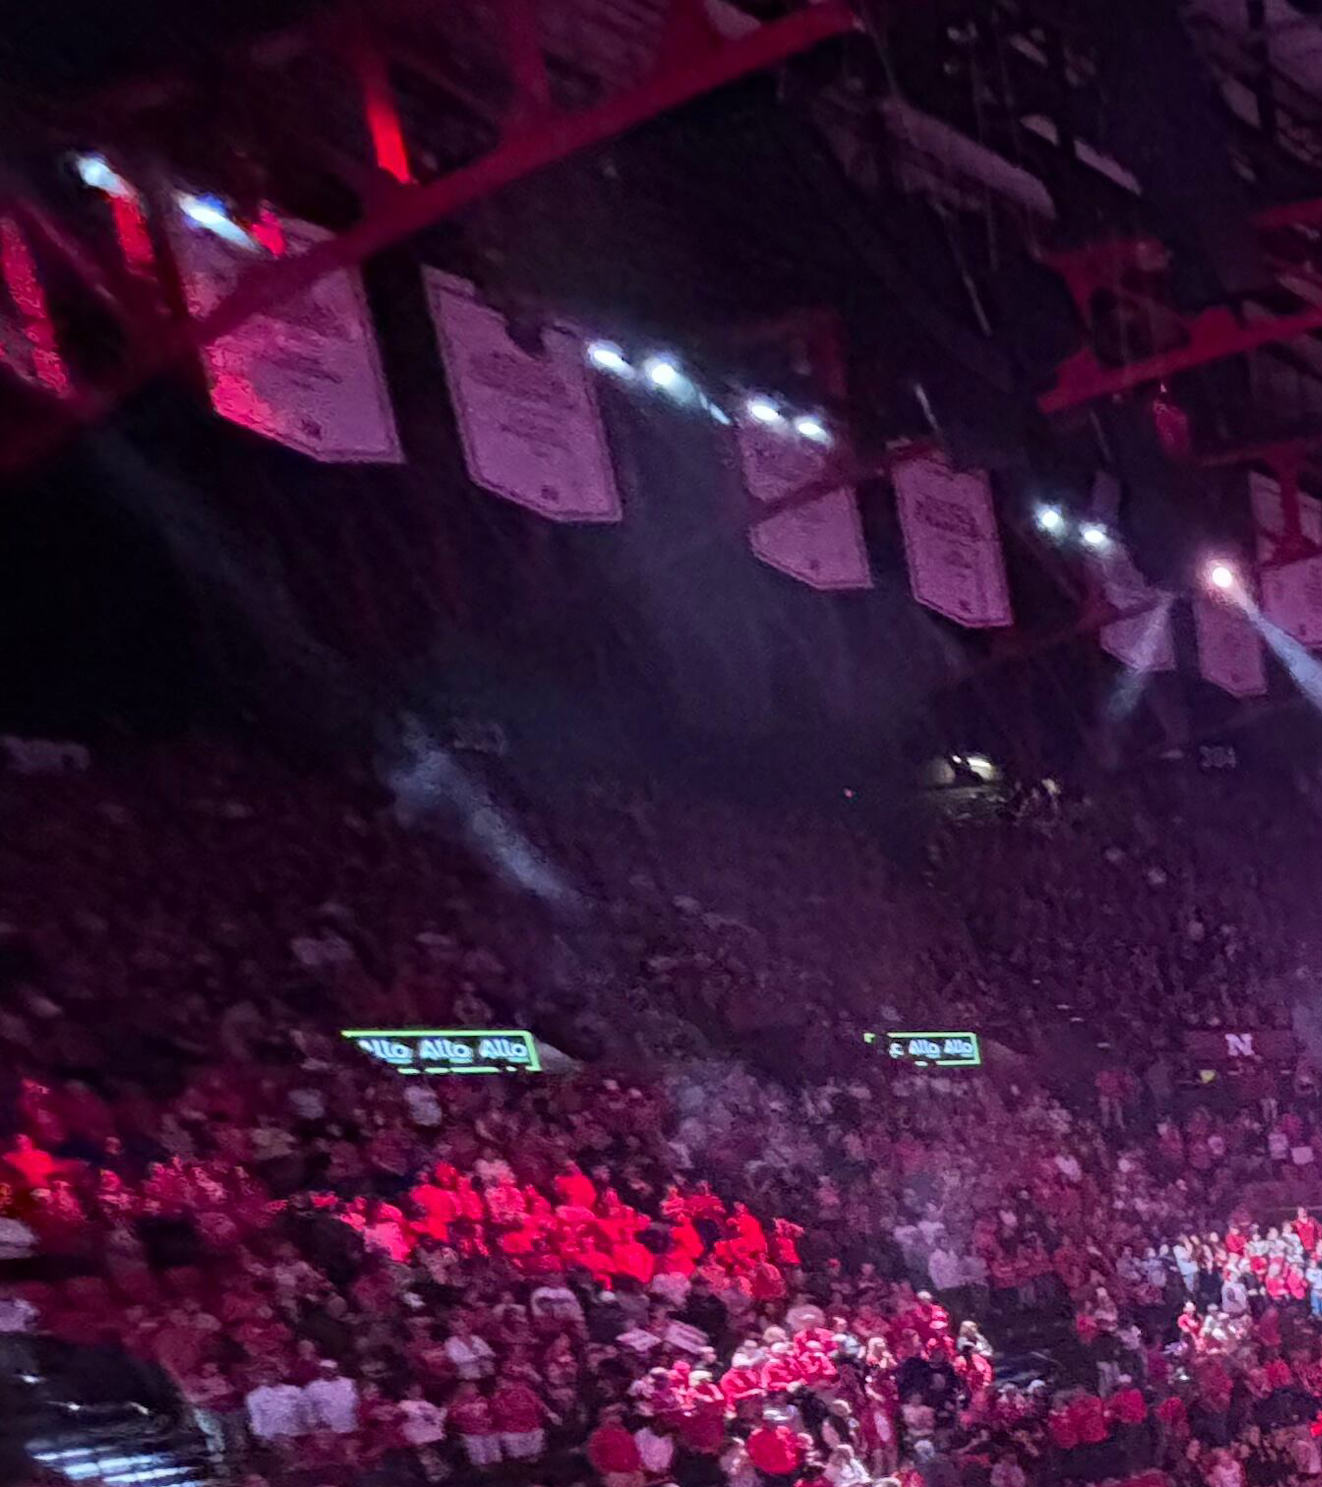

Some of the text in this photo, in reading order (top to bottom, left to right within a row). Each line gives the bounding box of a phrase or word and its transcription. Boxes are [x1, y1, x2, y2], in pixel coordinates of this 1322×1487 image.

[420, 1038, 473, 1060] Allo
[479, 1038, 528, 1059] Allo
[1224, 1033, 1255, 1056] N
